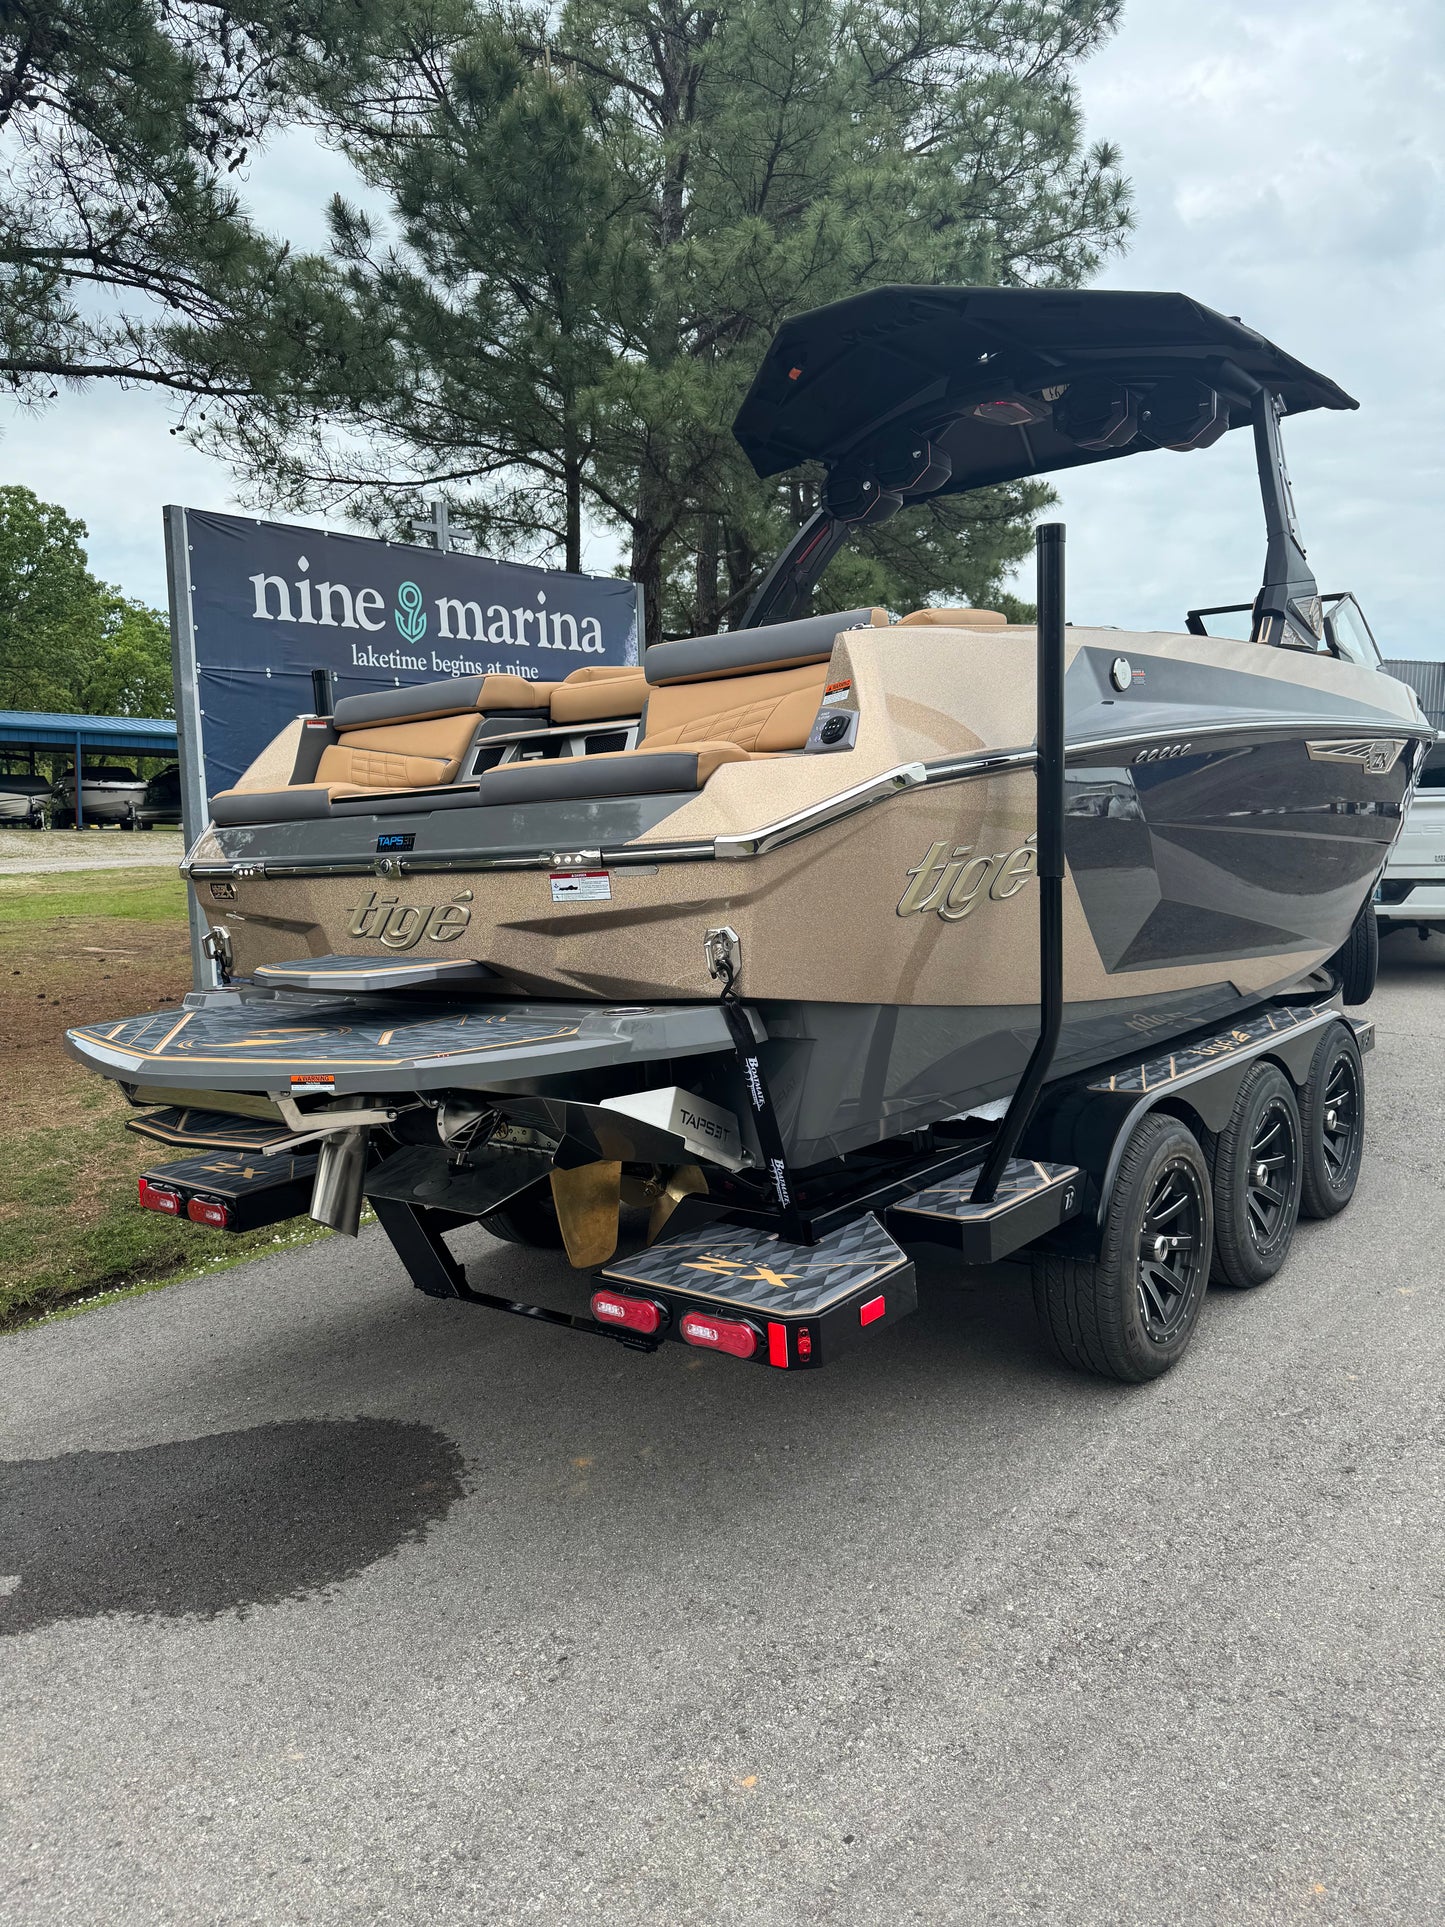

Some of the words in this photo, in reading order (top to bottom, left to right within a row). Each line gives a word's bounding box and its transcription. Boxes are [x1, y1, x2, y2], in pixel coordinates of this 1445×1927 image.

[248, 555, 387, 632] nine
[434, 590, 606, 654] marina
[351, 643, 428, 671] laketime
[431, 651, 483, 677] begins
[487, 661, 502, 674] at
[505, 660, 539, 679] nine
[896, 830, 1038, 923] tigé
[345, 888, 474, 952] tigé
[680, 1108, 731, 1141] TAPS3T
